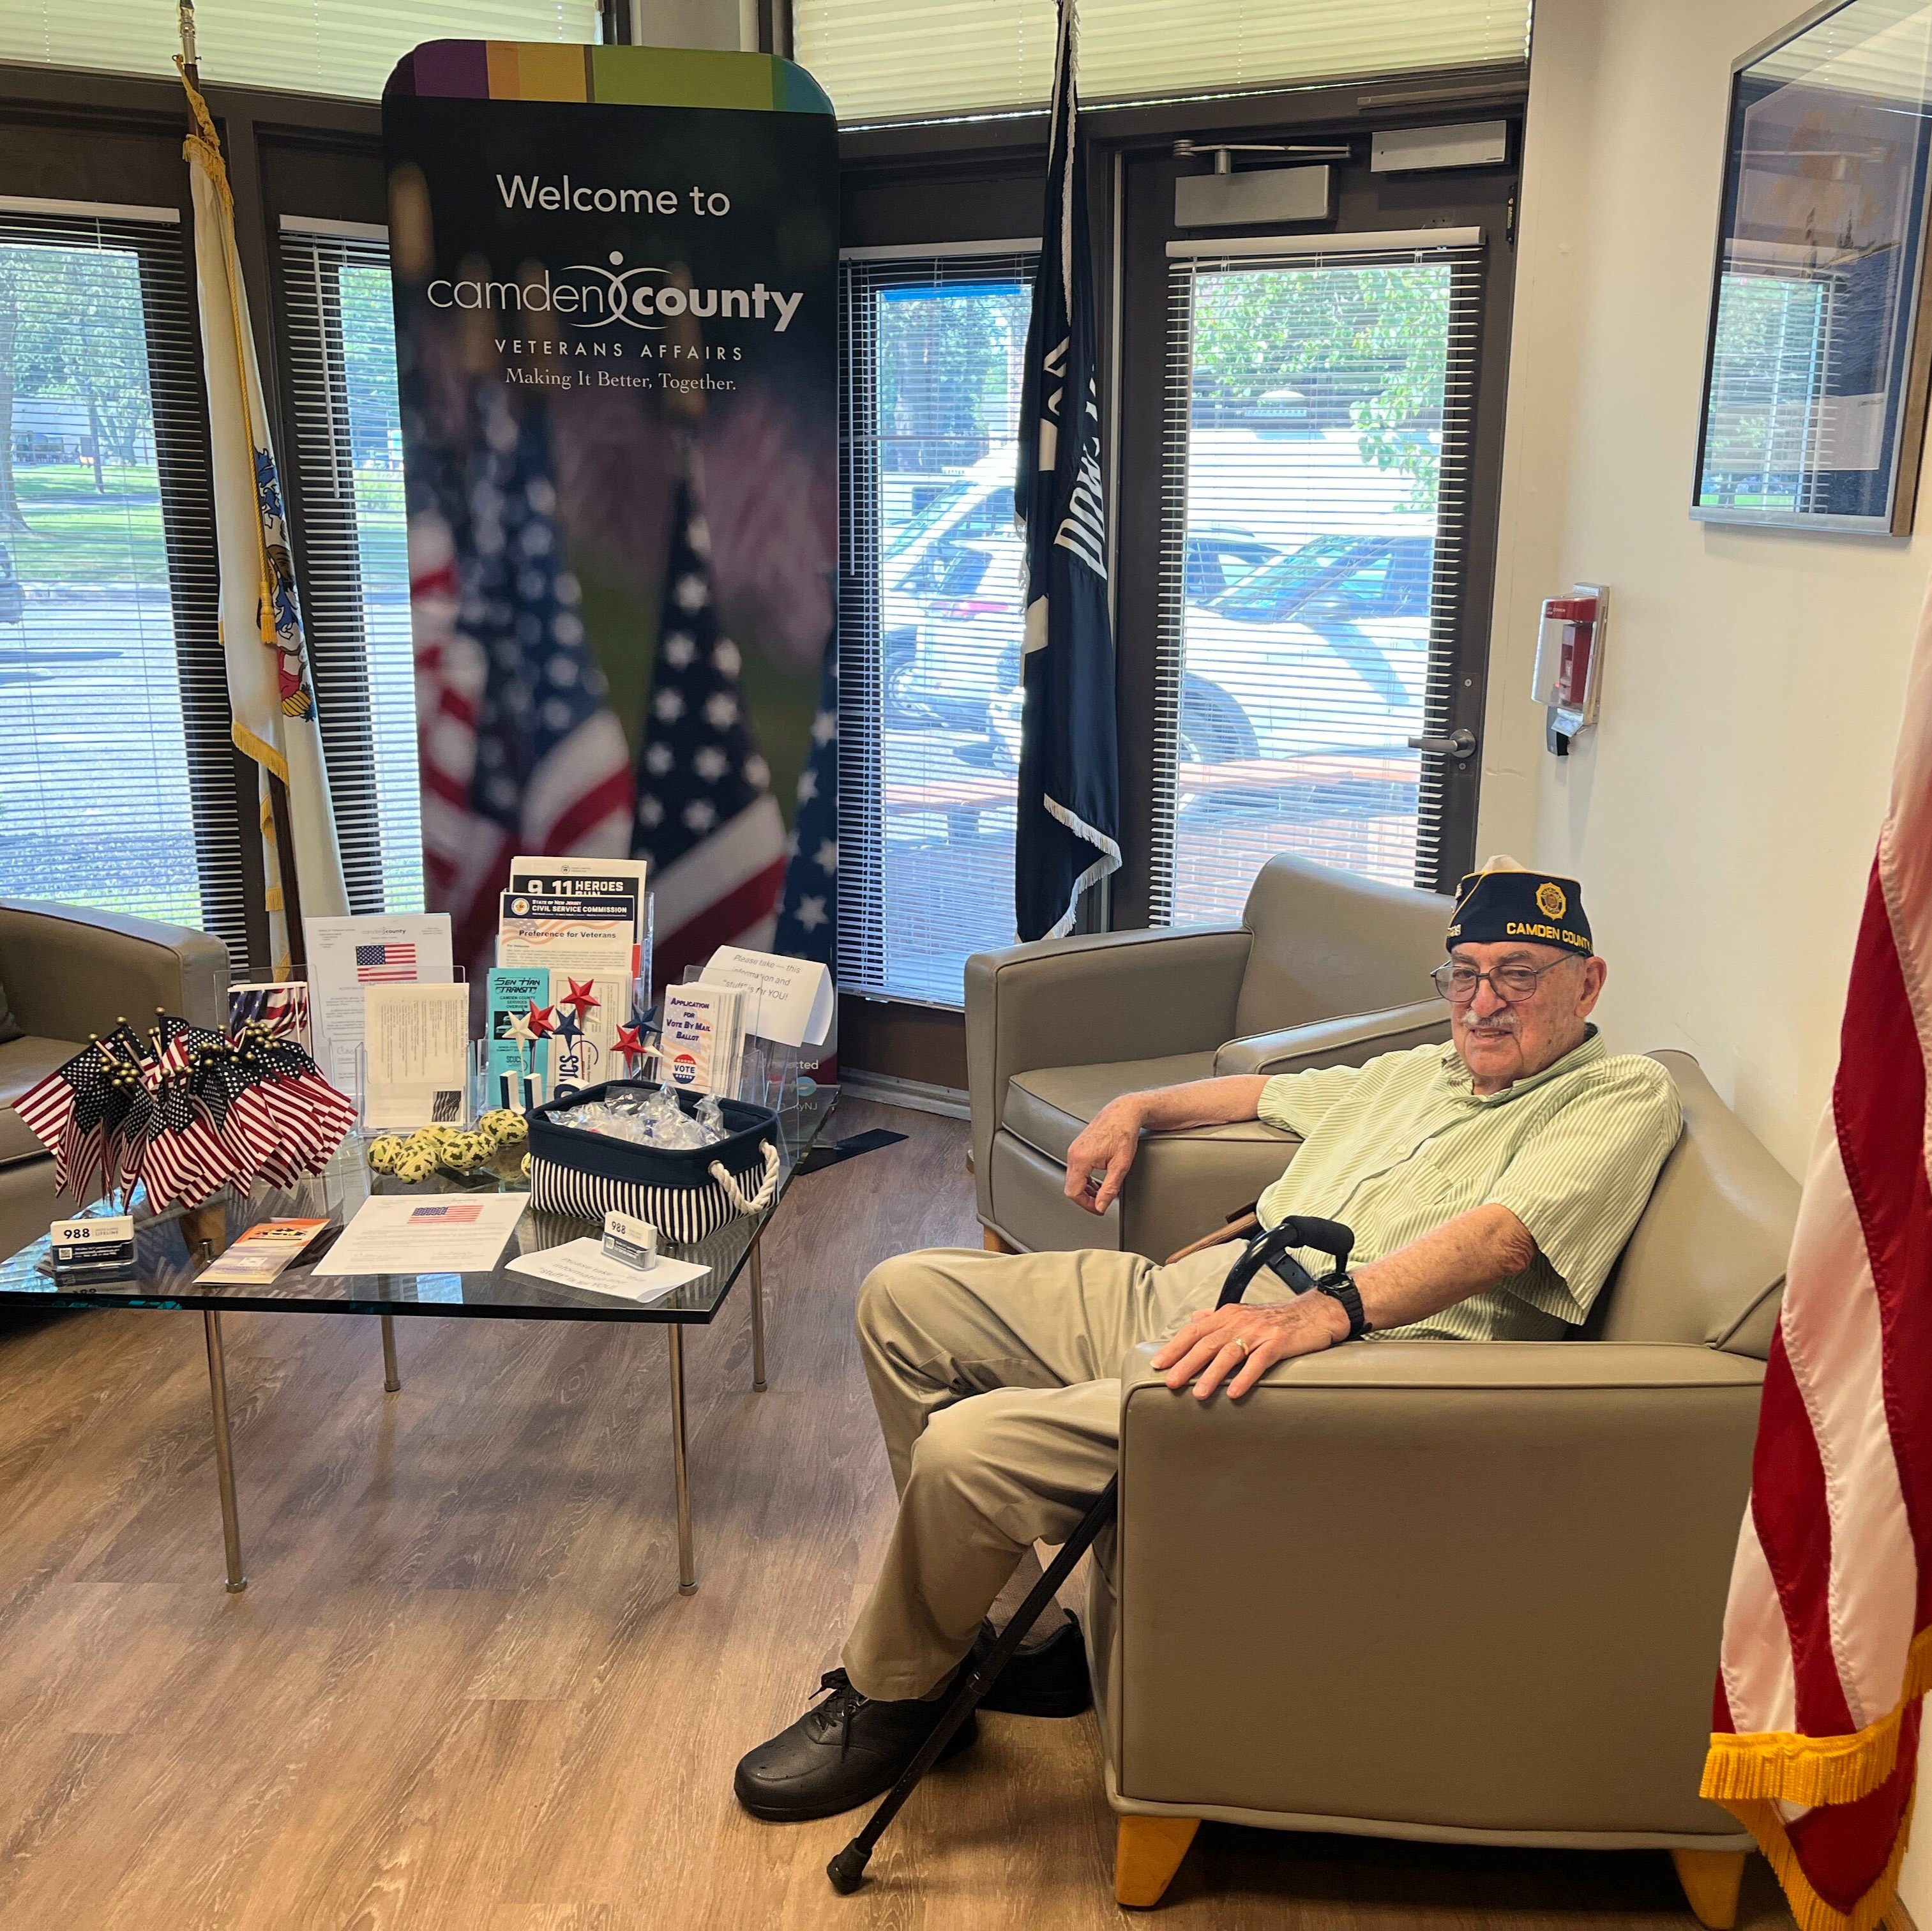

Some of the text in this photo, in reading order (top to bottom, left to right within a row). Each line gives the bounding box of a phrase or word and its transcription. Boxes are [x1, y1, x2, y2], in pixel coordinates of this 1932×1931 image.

[496, 174, 730, 216] Welcome to
[427, 269, 804, 332] camden county
[495, 338, 743, 361] VETERANS AFFAIRS
[506, 368, 737, 394] Making It Better, Together.
[575, 881, 623, 891] HEROES
[1506, 922, 1590, 951] CAMDEN COUNTY
[734, 955, 758, 965] Please
[758, 959, 775, 968] take
[786, 964, 801, 974] this
[775, 977, 791, 986] and
[767, 989, 789, 1001] YOU!
[670, 997, 710, 1009] APPLICATION
[675, 1031, 700, 1041] BALLOT
[674, 1064, 696, 1074] VOTE
[64, 1228, 90, 1239] 988
[612, 1221, 626, 1234] 988
